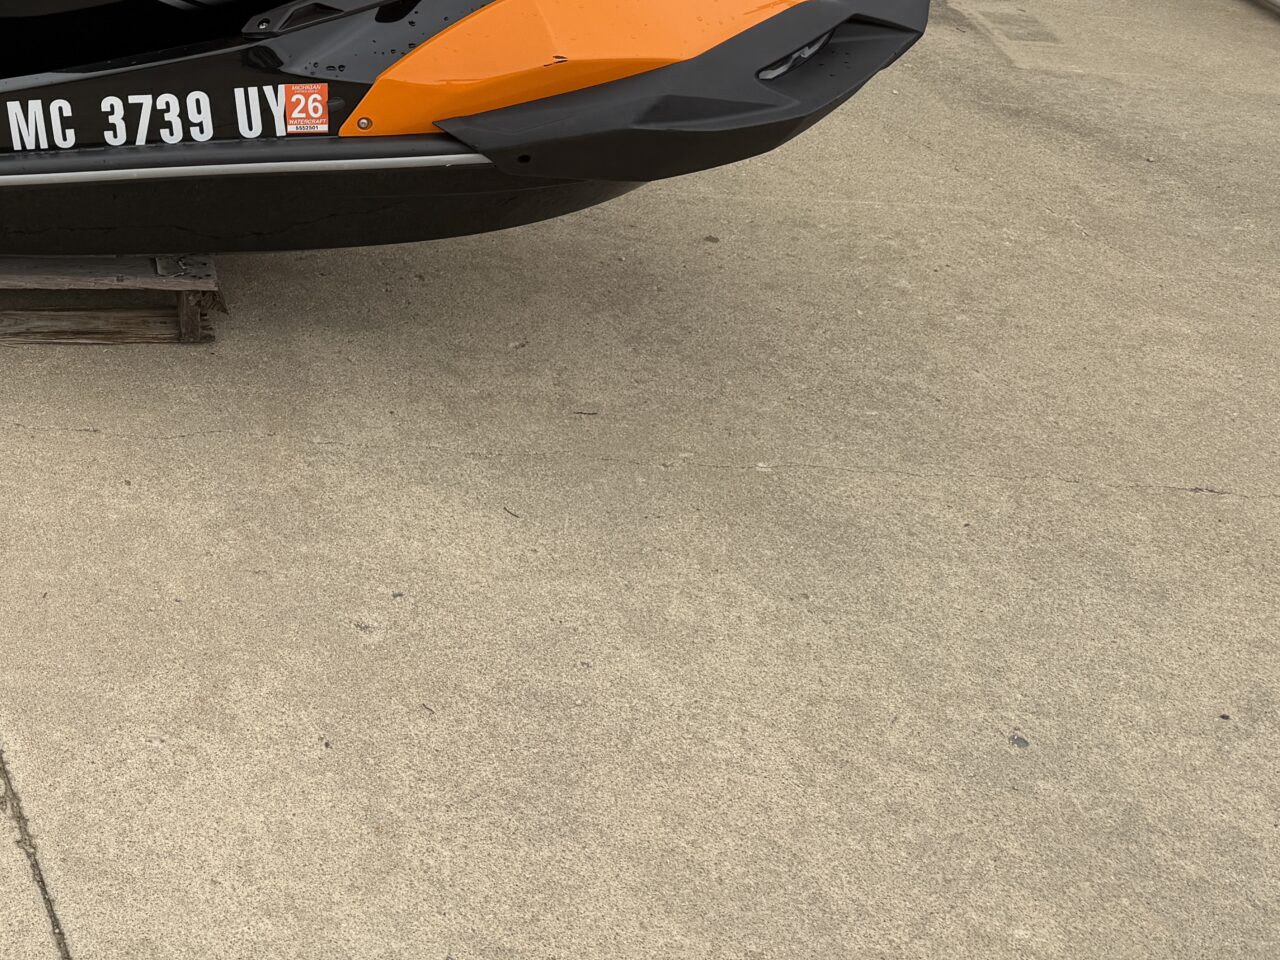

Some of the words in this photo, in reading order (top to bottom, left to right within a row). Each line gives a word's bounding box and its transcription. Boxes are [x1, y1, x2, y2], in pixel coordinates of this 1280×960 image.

[6, 99, 76, 151] MC
[100, 90, 214, 147] 3739
[234, 83, 287, 139] UY
[290, 93, 323, 119] 26
